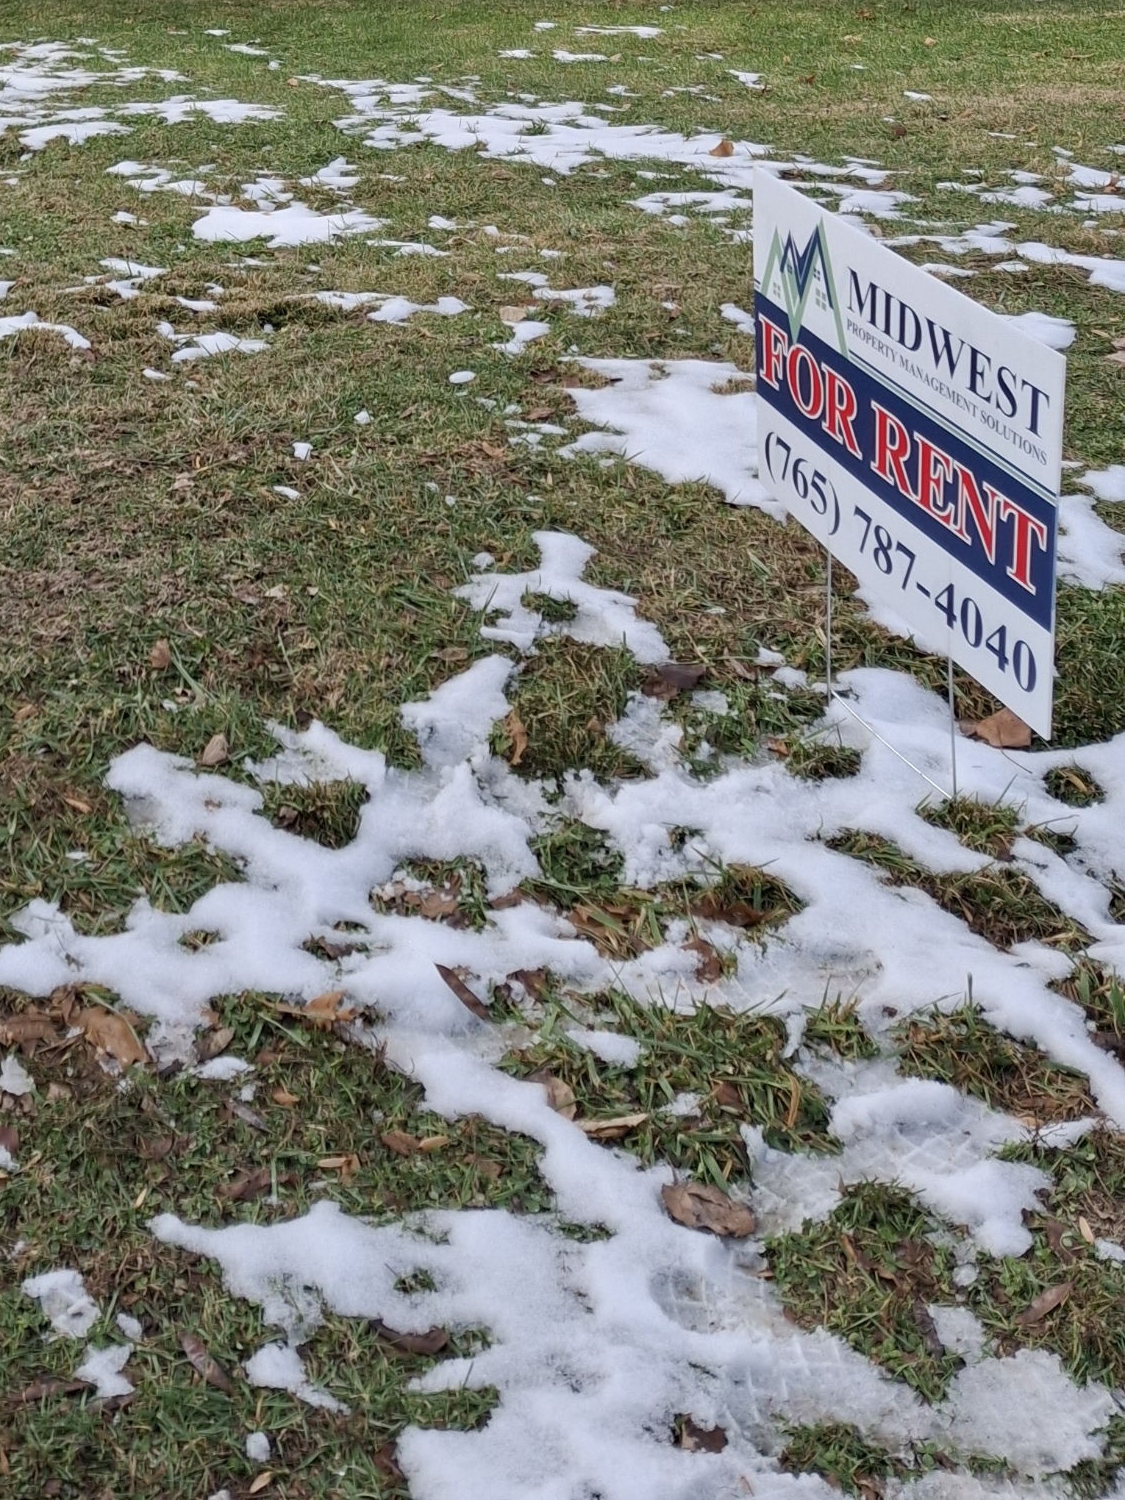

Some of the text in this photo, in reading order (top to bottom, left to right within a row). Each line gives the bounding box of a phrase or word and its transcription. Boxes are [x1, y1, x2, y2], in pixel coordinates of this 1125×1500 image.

[758, 312, 1047, 595] FOR RENT
[846, 318, 1047, 466] PROPERTY MANAGEMENT SOLUTIONS
[847, 266, 1050, 438] MIDWEST
[765, 431, 1037, 693] (765) 787-4040
